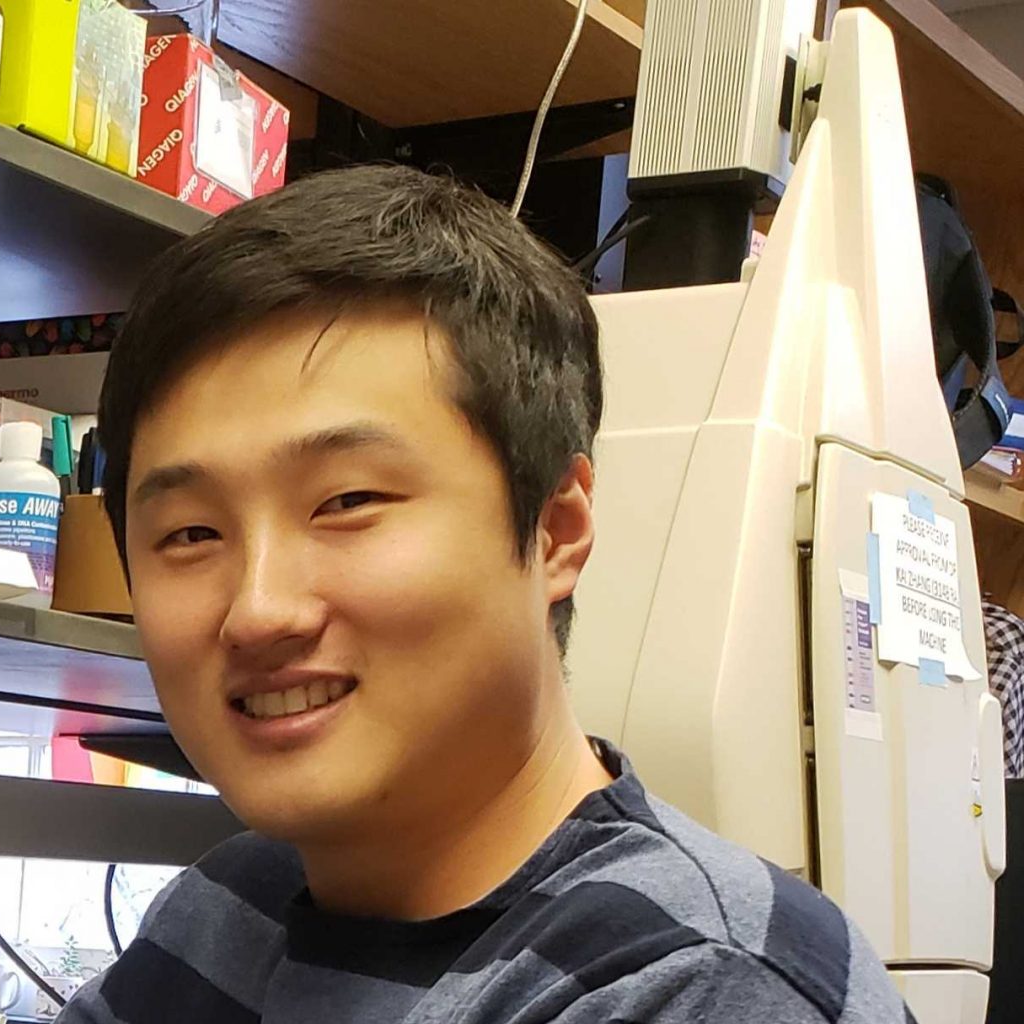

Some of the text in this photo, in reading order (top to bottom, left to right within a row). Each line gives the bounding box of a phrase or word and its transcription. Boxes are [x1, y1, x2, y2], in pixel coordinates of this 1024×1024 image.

[137, 128, 183, 177] QIAGEN
[22, 497, 59, 519] AWAY
[896, 538, 931, 568] APPROVAL
[908, 569, 931, 592] ZHANG
[902, 595, 961, 632] BEFORE USING THE
[919, 628, 947, 654] MACHINE
